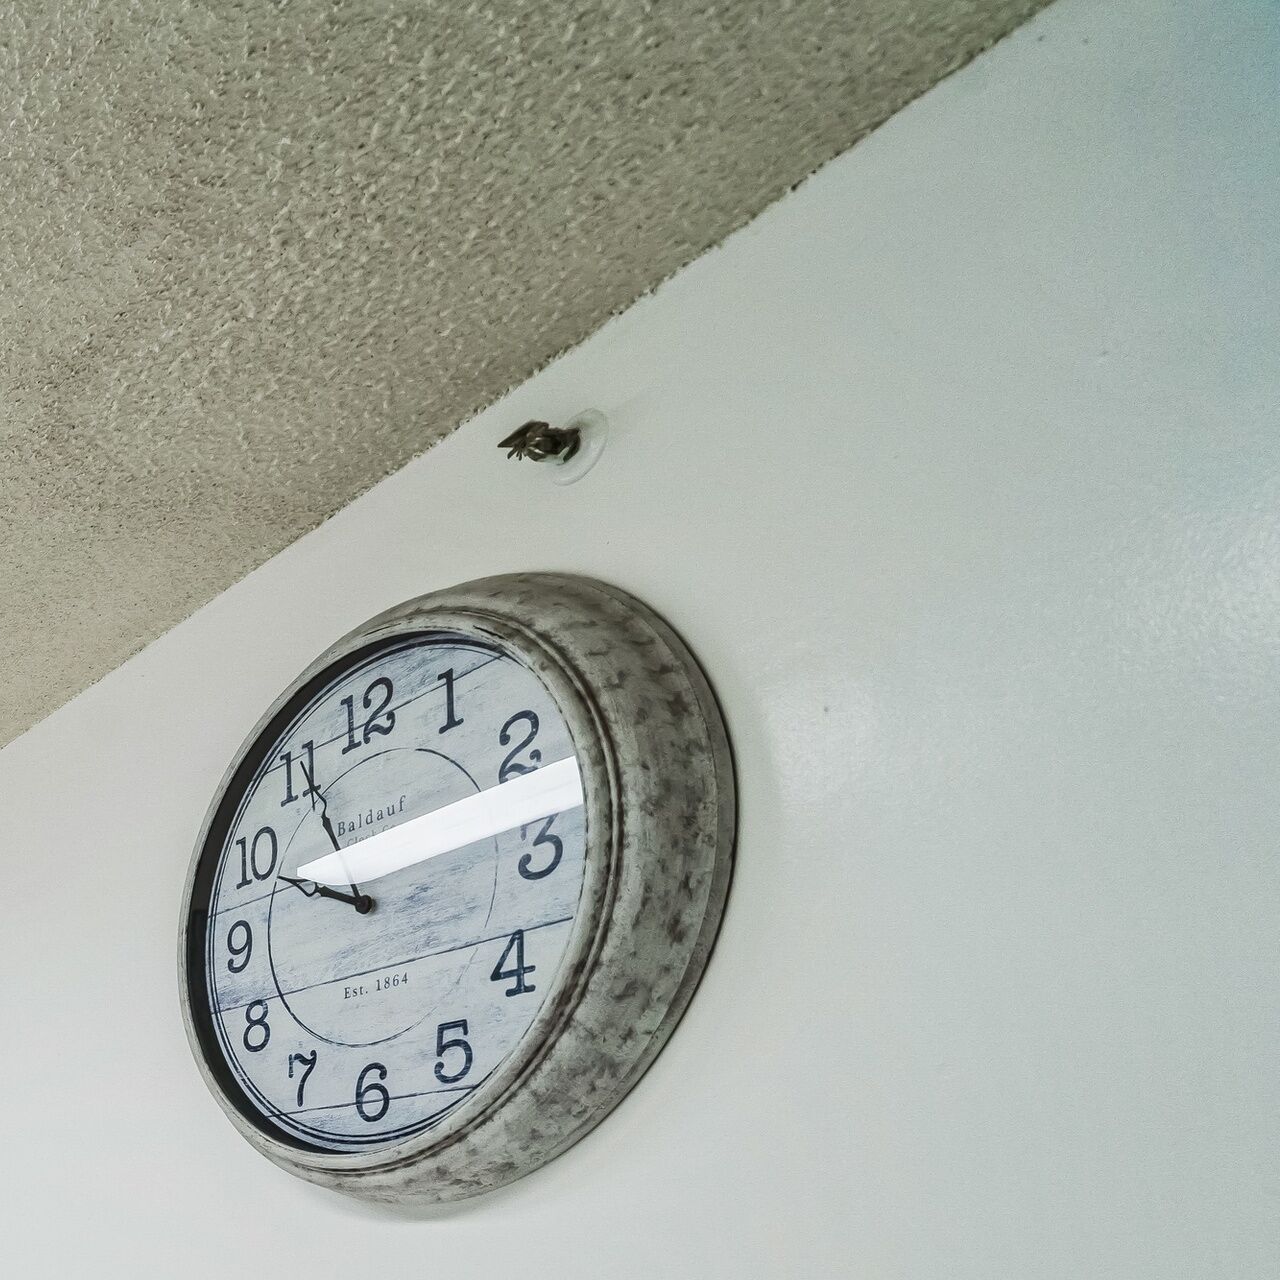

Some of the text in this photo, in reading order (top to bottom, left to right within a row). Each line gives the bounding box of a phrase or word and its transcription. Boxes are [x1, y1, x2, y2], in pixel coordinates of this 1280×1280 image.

[339, 676, 396, 755] 12
[437, 668, 464, 735] 1
[280, 740, 322, 808] 11
[498, 709, 542, 785] 2
[336, 795, 407, 838] Baldauf
[518, 813, 564, 881] 3
[236, 826, 278, 890] 10
[226, 920, 253, 974] 9
[490, 929, 537, 998] 4
[343, 972, 408, 1000] Est. 1864
[243, 1000, 270, 1053] 8
[434, 1019, 473, 1084] 5
[288, 1049, 317, 1107] 7
[355, 1063, 390, 1123] 6
